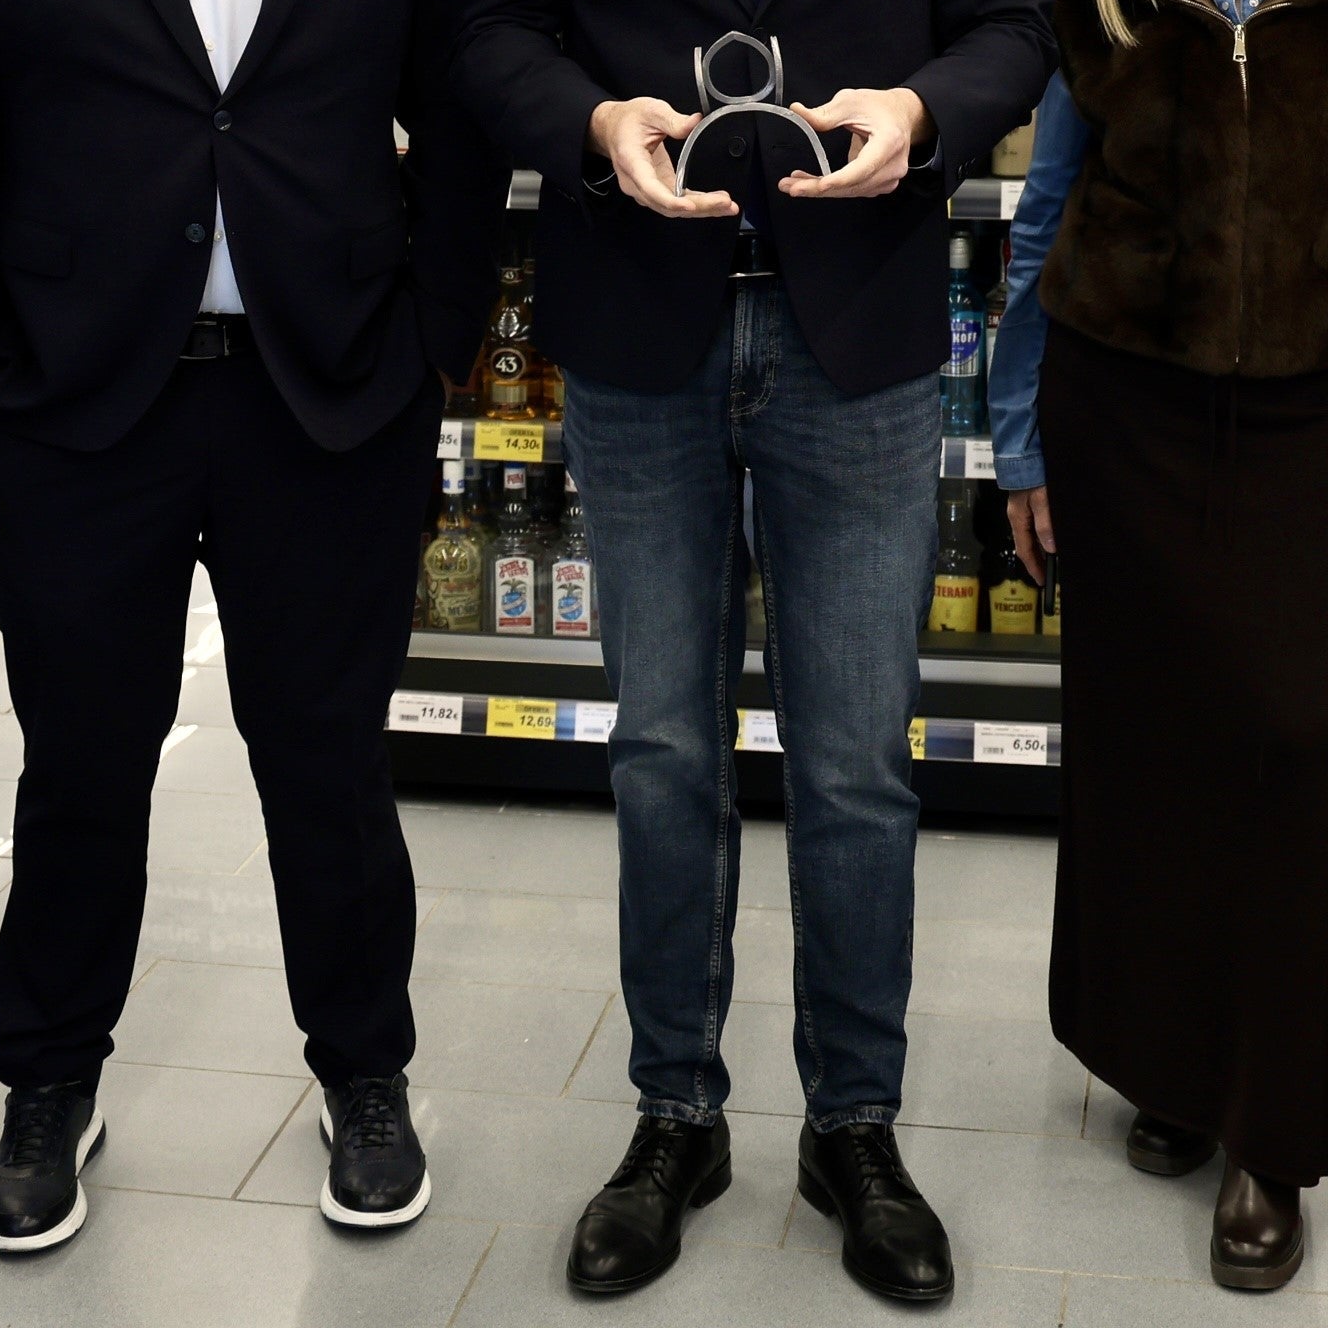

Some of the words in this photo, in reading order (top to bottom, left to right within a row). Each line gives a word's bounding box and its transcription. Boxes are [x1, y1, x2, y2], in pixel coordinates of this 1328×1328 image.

[495, 356, 519, 373] 43
[505, 438, 540, 451] 14,30€
[934, 585, 974, 598] TERANO
[421, 707, 459, 722] 11,82€
[1013, 739, 1047, 753] 6,50€
